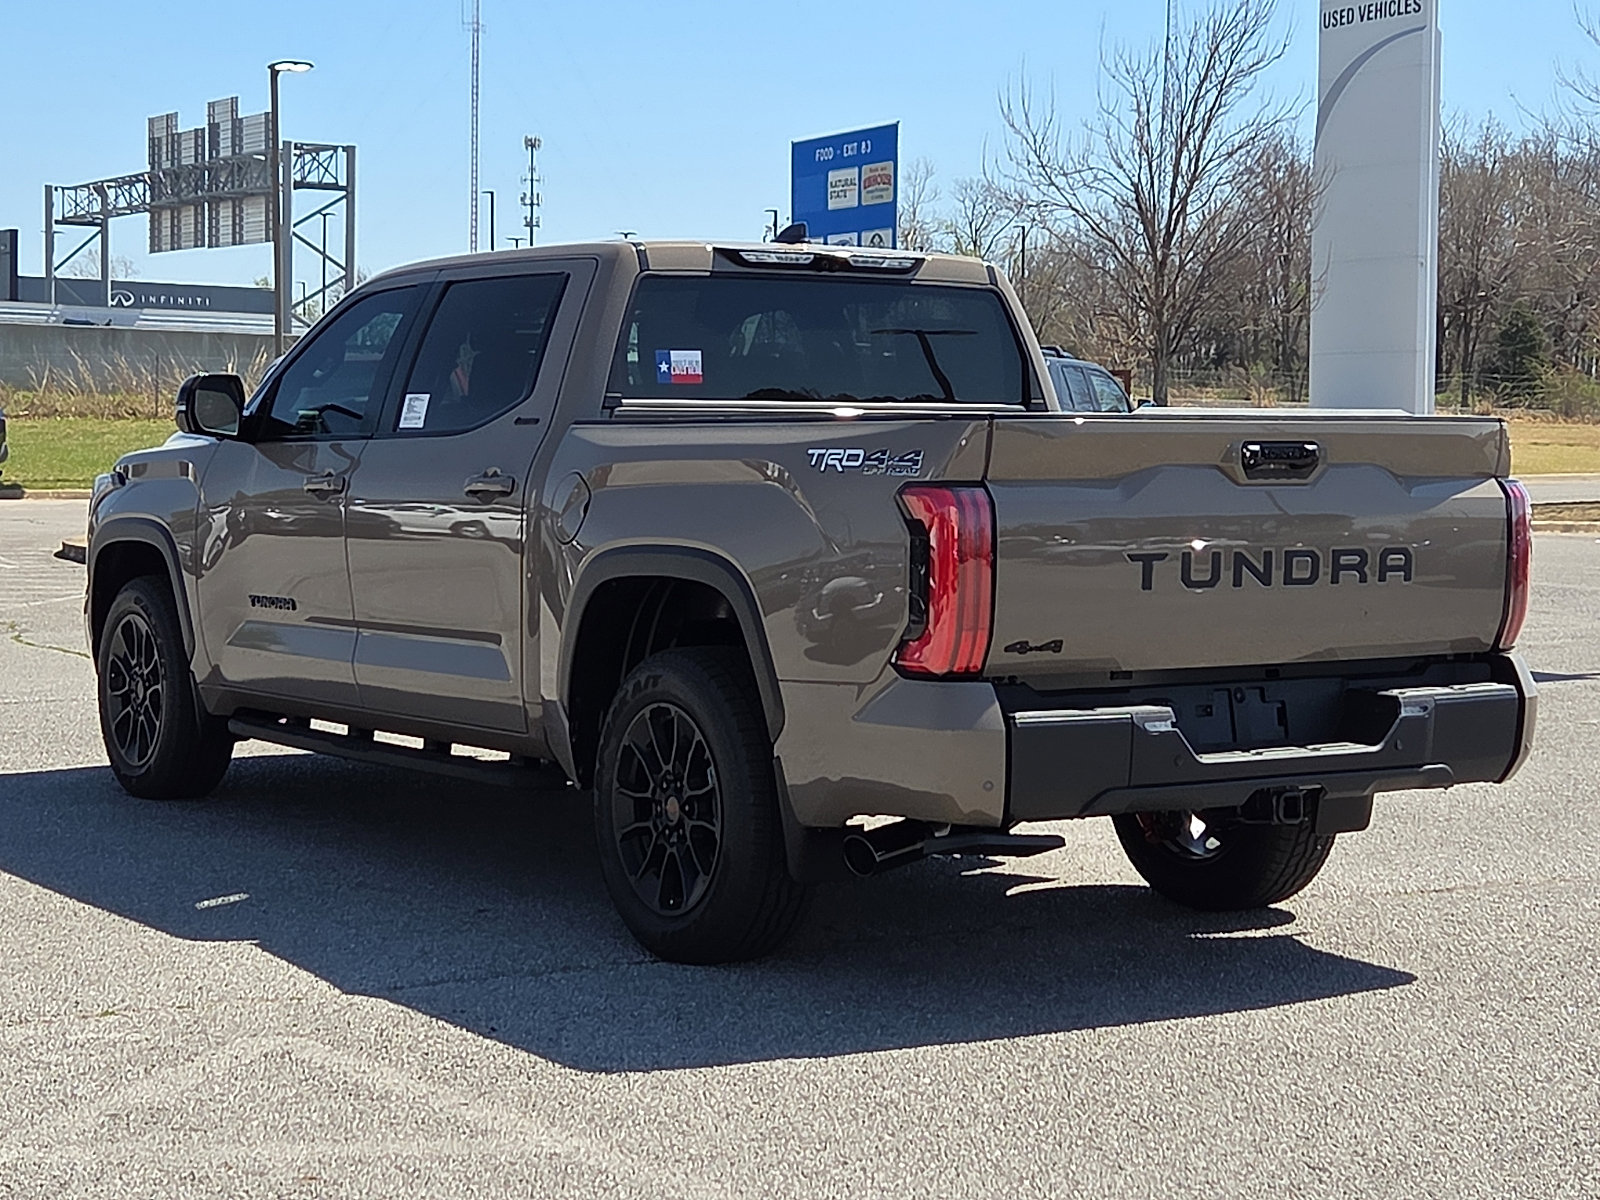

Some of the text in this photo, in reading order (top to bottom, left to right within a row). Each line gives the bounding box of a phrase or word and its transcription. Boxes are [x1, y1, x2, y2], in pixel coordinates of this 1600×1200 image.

[1323, 0, 1422, 29] USED VEHICLES
[815, 146, 834, 162] FOOD
[843, 141, 858, 158] EXIT
[830, 177, 857, 189] NATURAL
[830, 188, 848, 201] STATE
[141, 294, 210, 306] INFINITI
[807, 448, 865, 473] TRD
[1125, 547, 1413, 591] TUNDRA
[247, 594, 298, 611] TUNDRA
